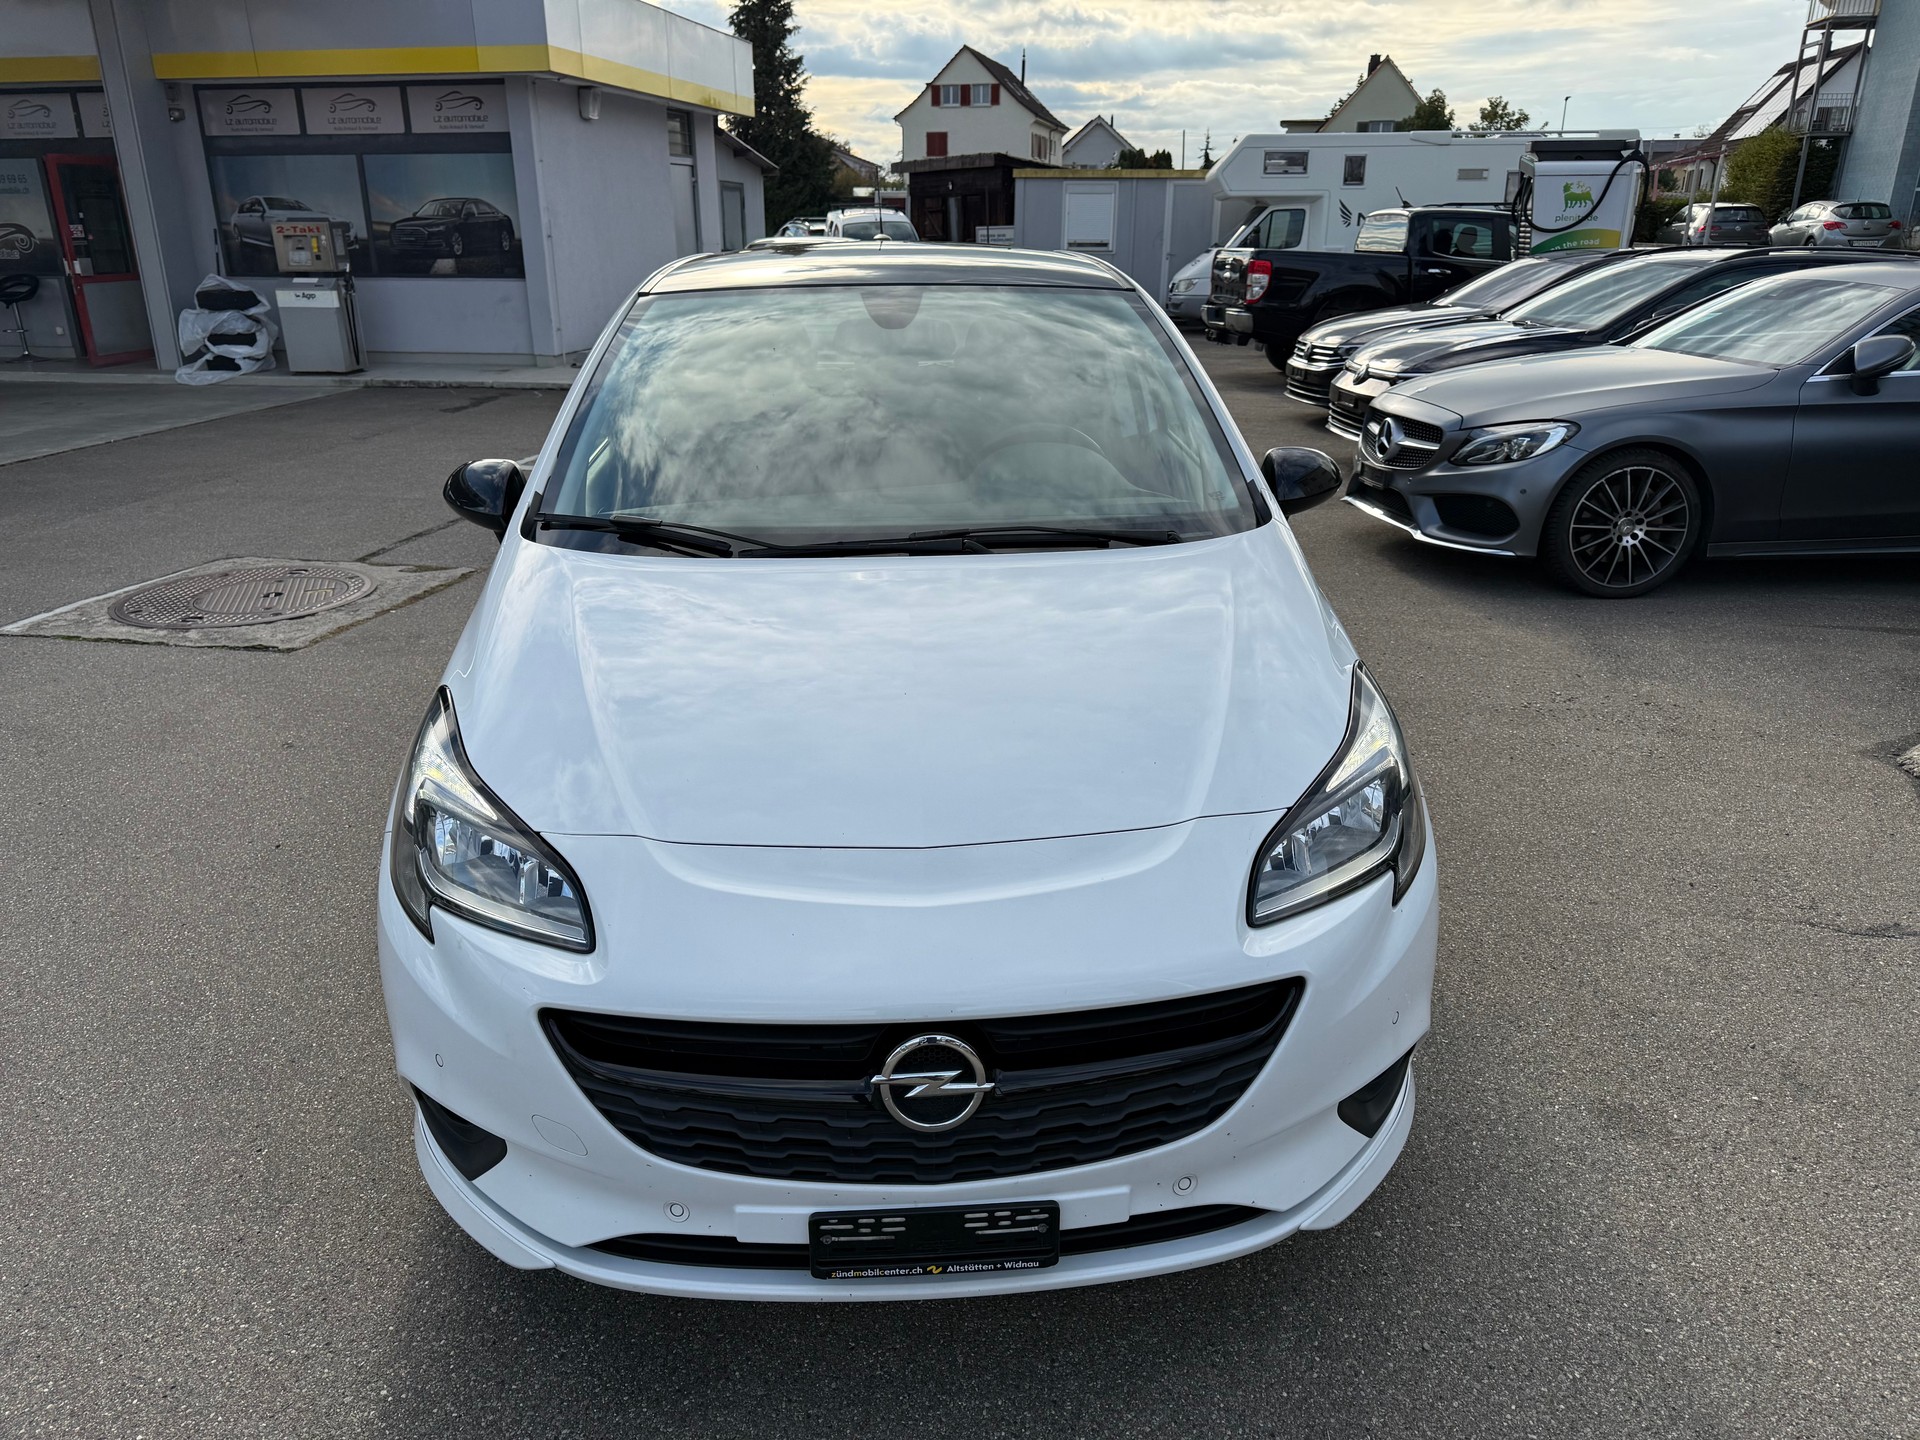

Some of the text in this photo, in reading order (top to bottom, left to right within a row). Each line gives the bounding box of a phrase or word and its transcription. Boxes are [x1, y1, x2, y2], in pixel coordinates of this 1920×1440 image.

[1555, 214, 1599, 223] plenitde
[276, 225, 321, 234] 2-Takt
[1563, 241, 1578, 249] the
[1580, 238, 1600, 246] road
[831, 1266, 923, 1278] zündmobilcenter.ch
[946, 1263, 994, 1272] Altstätten
[1003, 1261, 1040, 1269] Widnau
